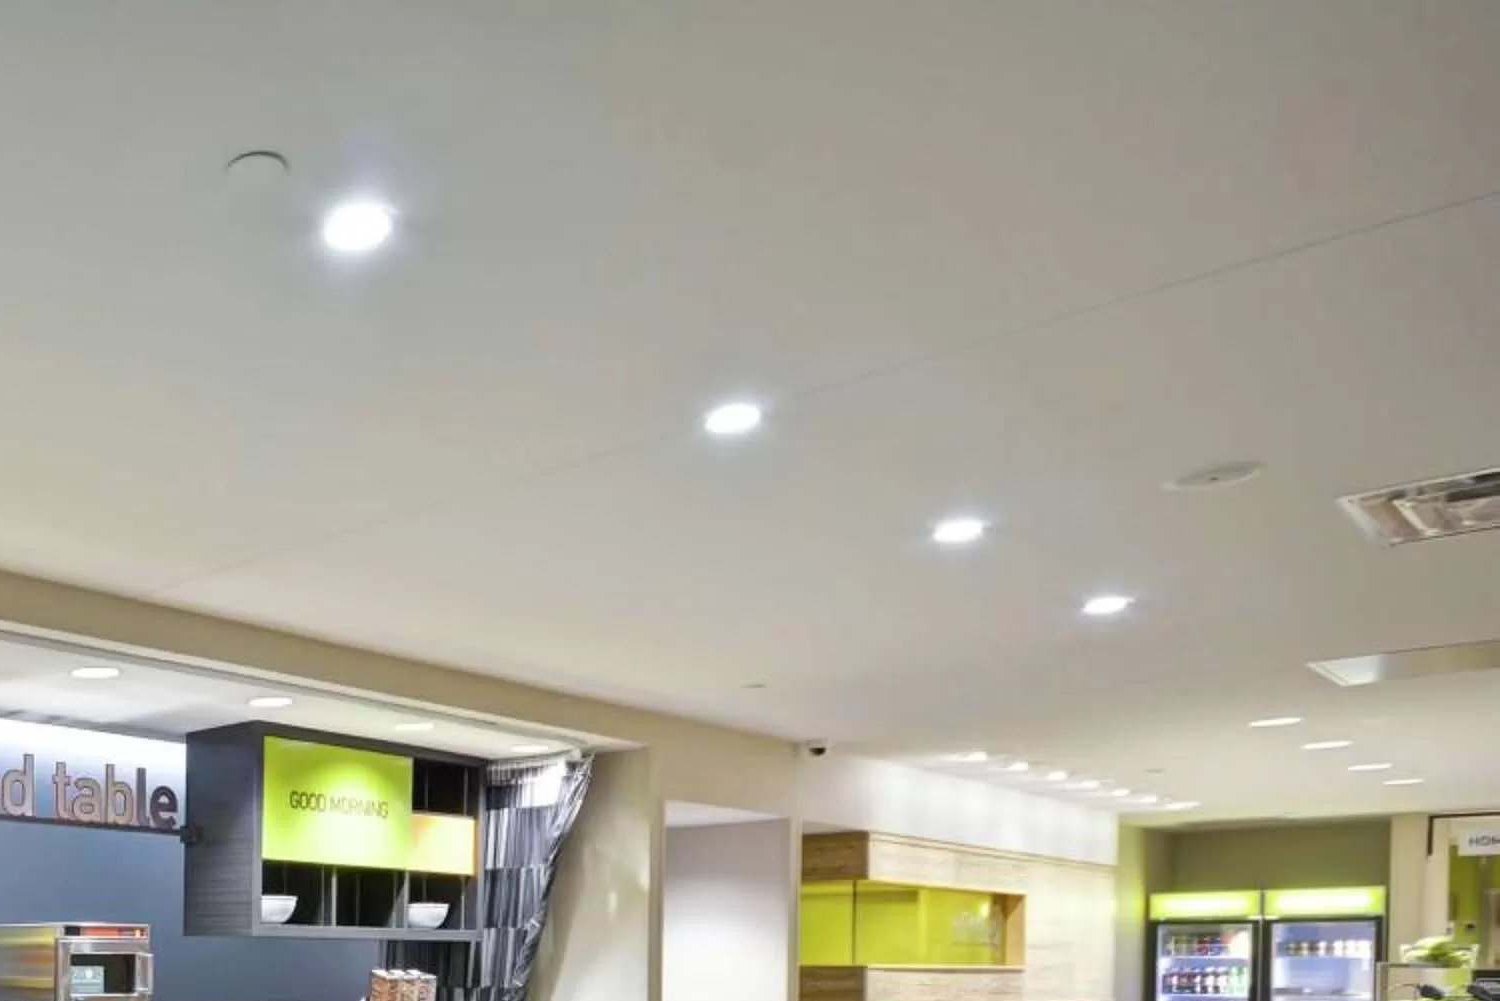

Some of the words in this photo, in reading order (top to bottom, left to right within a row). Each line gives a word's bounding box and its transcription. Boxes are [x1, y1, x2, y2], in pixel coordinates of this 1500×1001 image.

[52, 761, 178, 828] table
[289, 790, 327, 812] GOOD
[329, 795, 389, 819] MORNING
